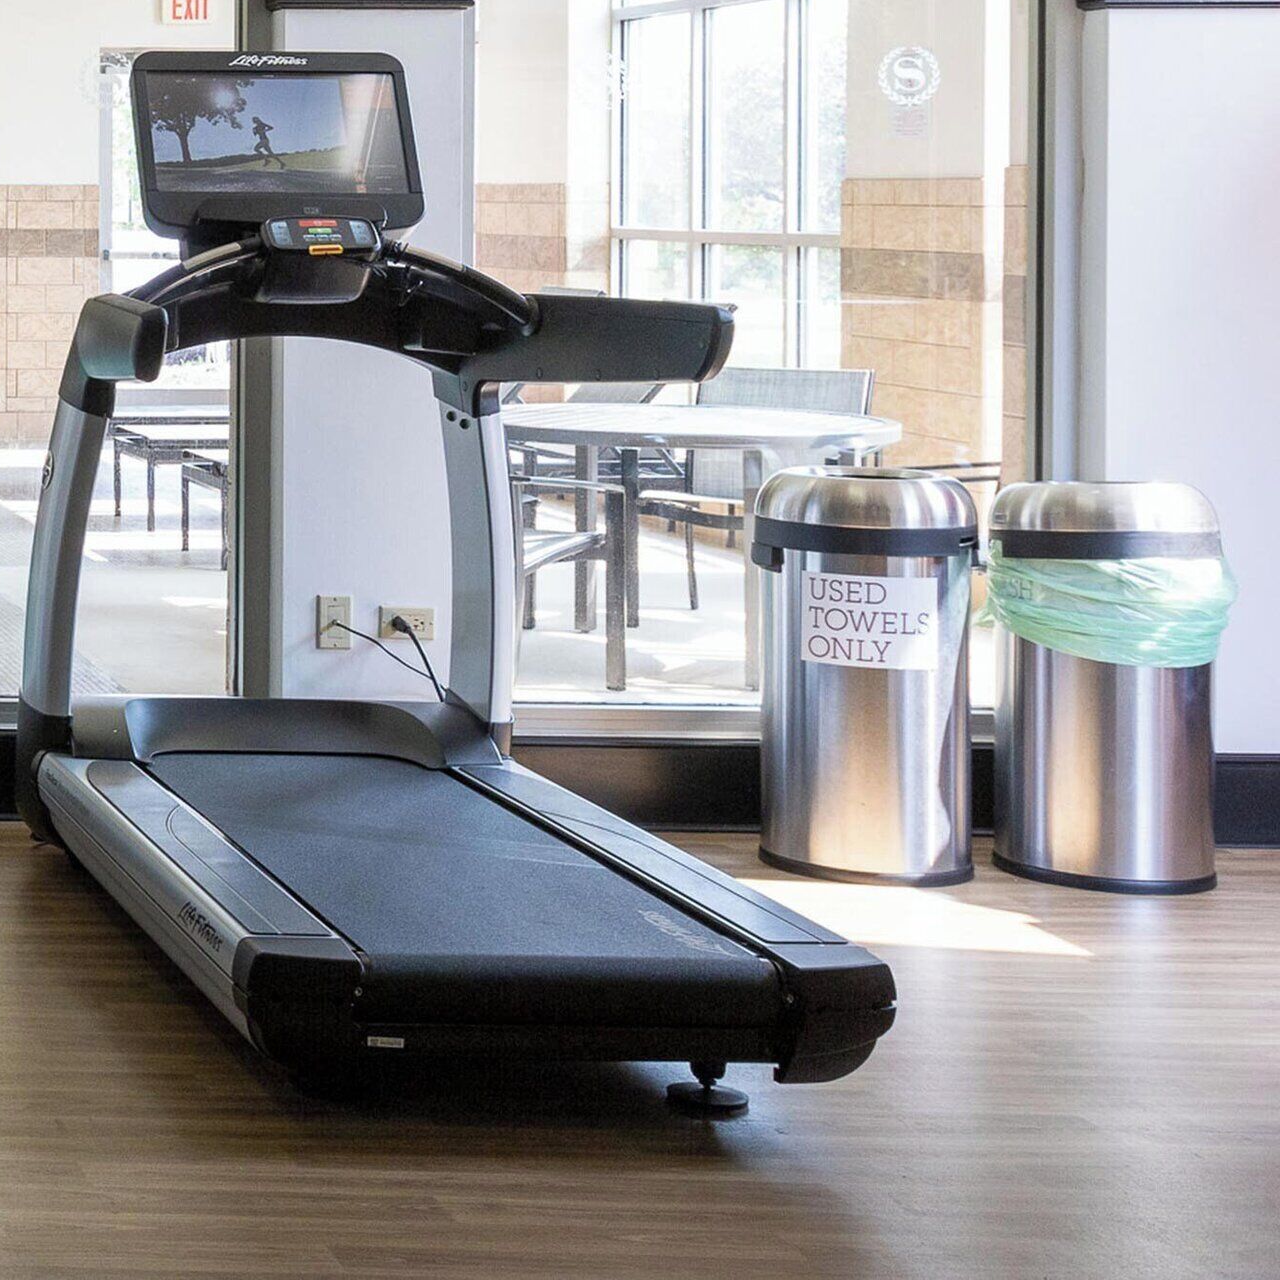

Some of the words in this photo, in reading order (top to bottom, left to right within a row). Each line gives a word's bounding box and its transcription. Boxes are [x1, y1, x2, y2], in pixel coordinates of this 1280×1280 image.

[894, 56, 927, 91] S
[809, 577, 887, 605] USED
[808, 606, 930, 635] TOWELS
[808, 635, 892, 662] ONLY
